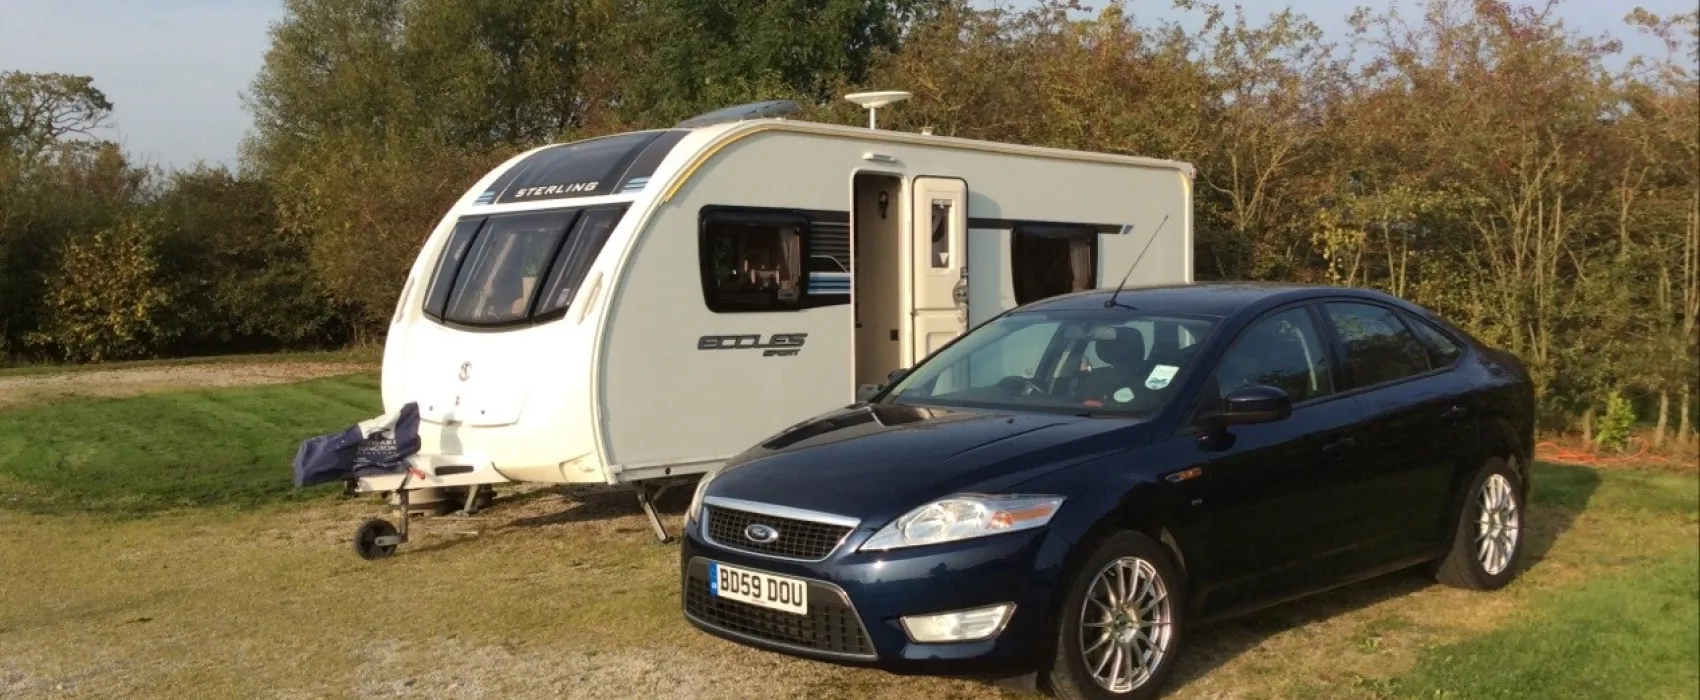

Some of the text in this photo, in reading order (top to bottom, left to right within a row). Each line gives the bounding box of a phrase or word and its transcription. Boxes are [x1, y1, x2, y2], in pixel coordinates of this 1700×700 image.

[515, 181, 599, 198] STERLING
[697, 333, 809, 350] ECCLES
[720, 568, 803, 607] BD59 DOU
